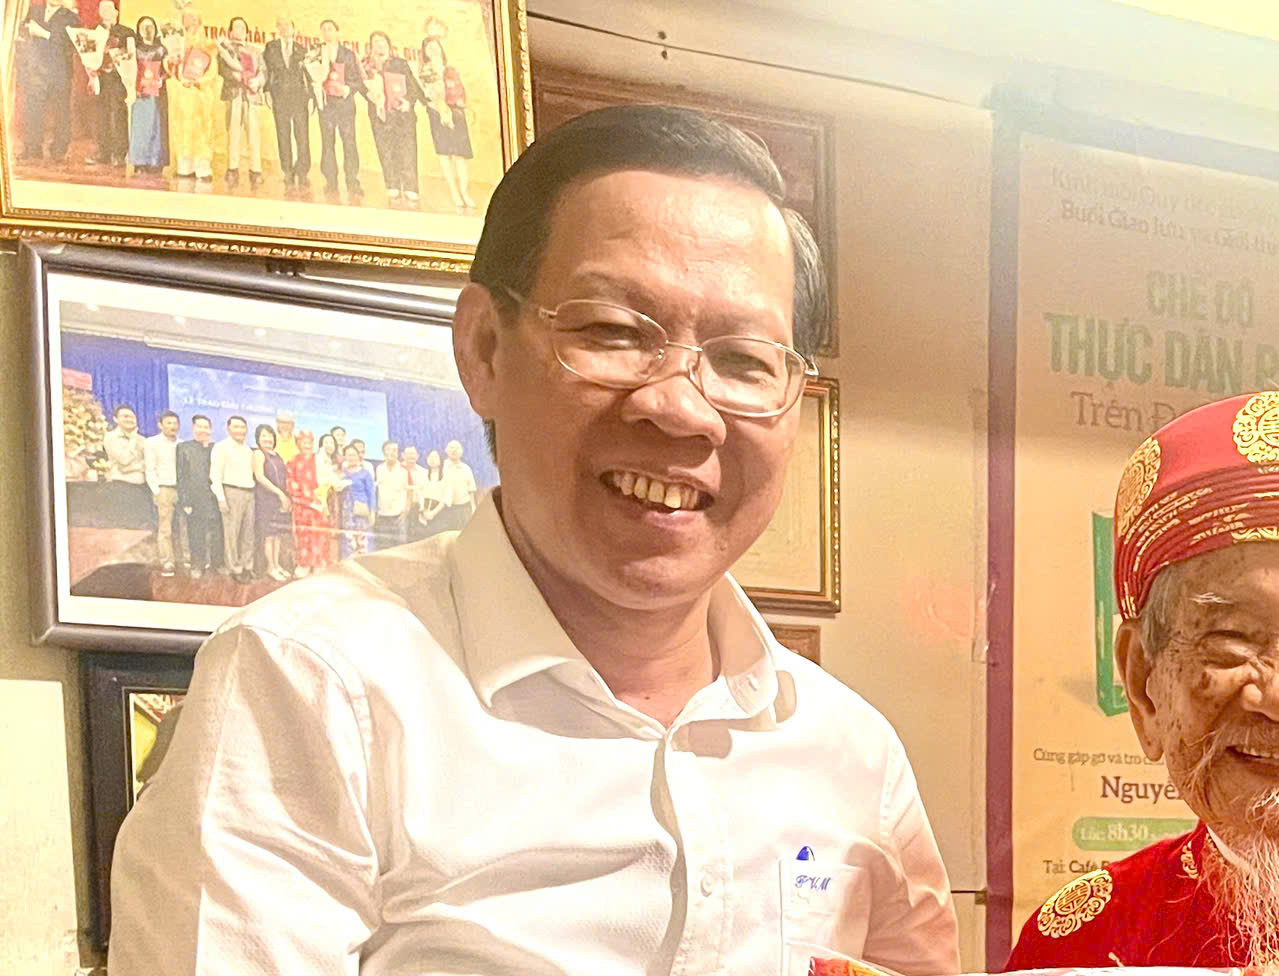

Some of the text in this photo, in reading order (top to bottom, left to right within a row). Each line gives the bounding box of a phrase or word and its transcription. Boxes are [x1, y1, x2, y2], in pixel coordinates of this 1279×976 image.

[1042, 311, 1153, 390] THỰC
[1165, 328, 1244, 395] DÂN
[1100, 775, 1181, 805] Nguyễ
[1106, 821, 1149, 842] 8h30
